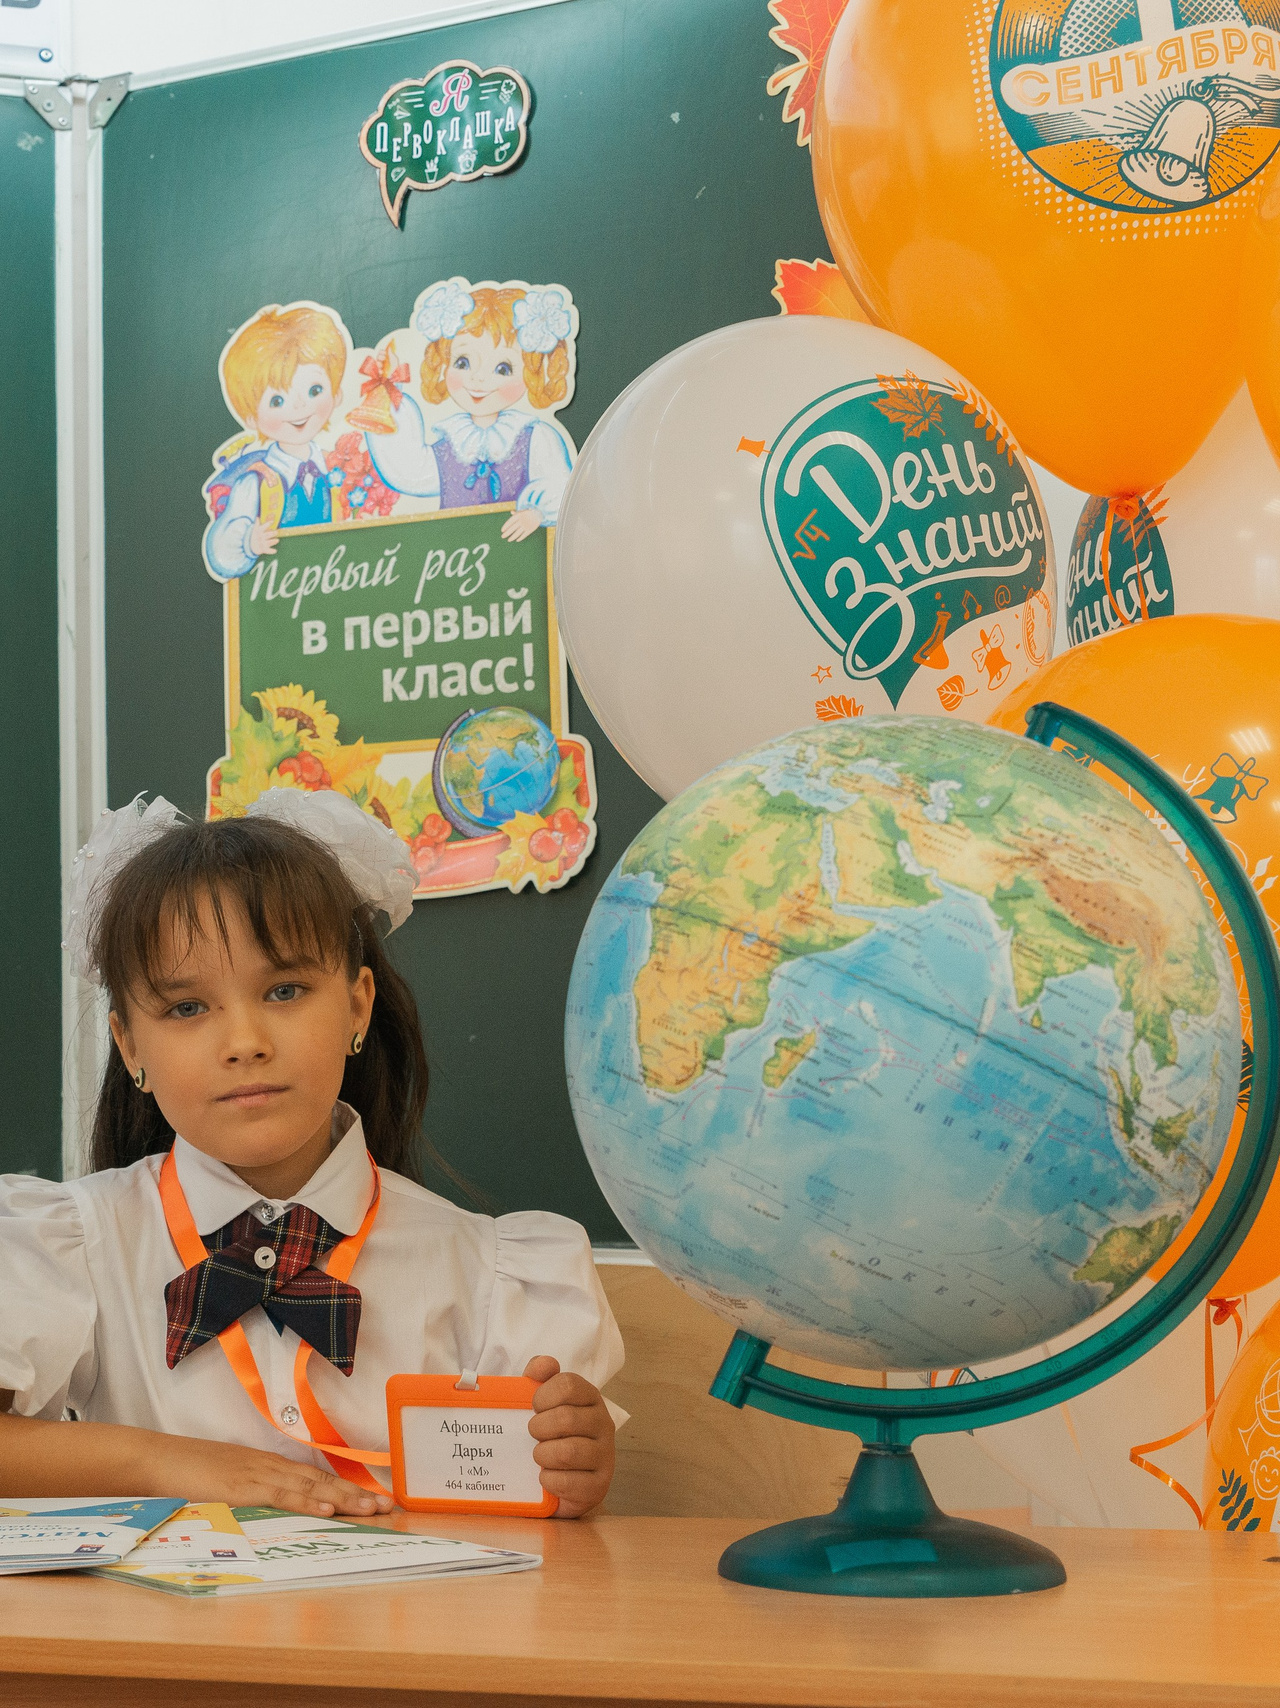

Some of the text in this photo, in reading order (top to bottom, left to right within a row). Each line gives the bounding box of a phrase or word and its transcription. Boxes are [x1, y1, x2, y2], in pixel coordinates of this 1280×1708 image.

[428, 68, 473, 117] Я
[1011, 28, 1277, 108] СЕНТЯБРЯ
[374, 105, 517, 164] ПЕРВОКЛАШКА
[783, 430, 997, 544] День
[249, 541, 491, 620] Первый раз
[824, 484, 1044, 680] Знаний
[301, 586, 533, 658] в первый
[381, 642, 537, 704] класс!
[439, 1419, 504, 1437] Афонина
[451, 1443, 494, 1461] Дарья
[444, 1479, 507, 1492] 464 кабинет
[459, 1465, 490, 1477] 1 «М»
